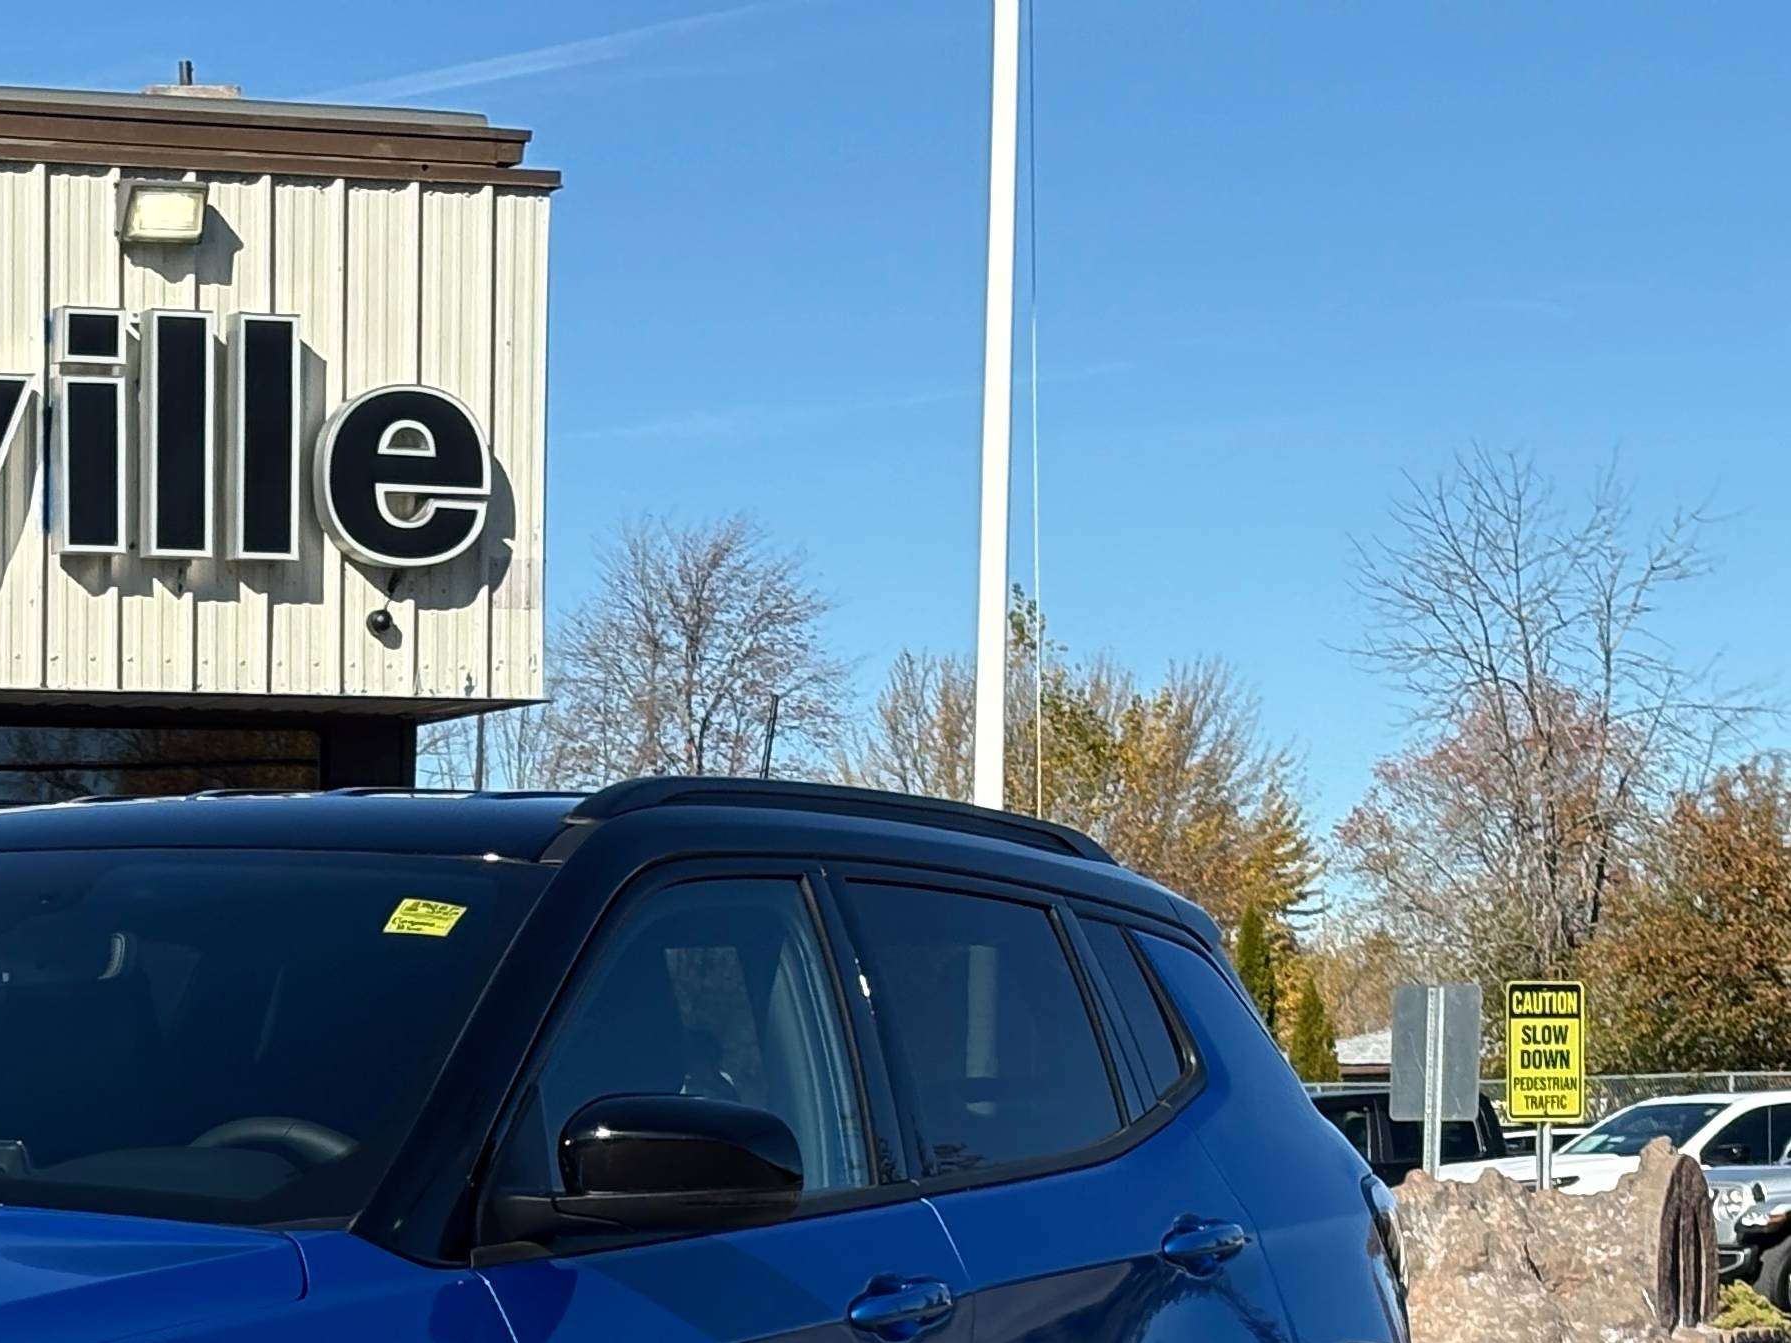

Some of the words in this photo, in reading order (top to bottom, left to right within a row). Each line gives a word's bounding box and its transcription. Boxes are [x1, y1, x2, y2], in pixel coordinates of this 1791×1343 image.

[1512, 990, 1578, 1015] CAUTION
[1521, 1024, 1569, 1046] SLOW
[1520, 1049, 1571, 1070] DOWN
[1513, 1076, 1578, 1092] PEDESTRIAN
[1523, 1094, 1568, 1110] TRAFFIC
